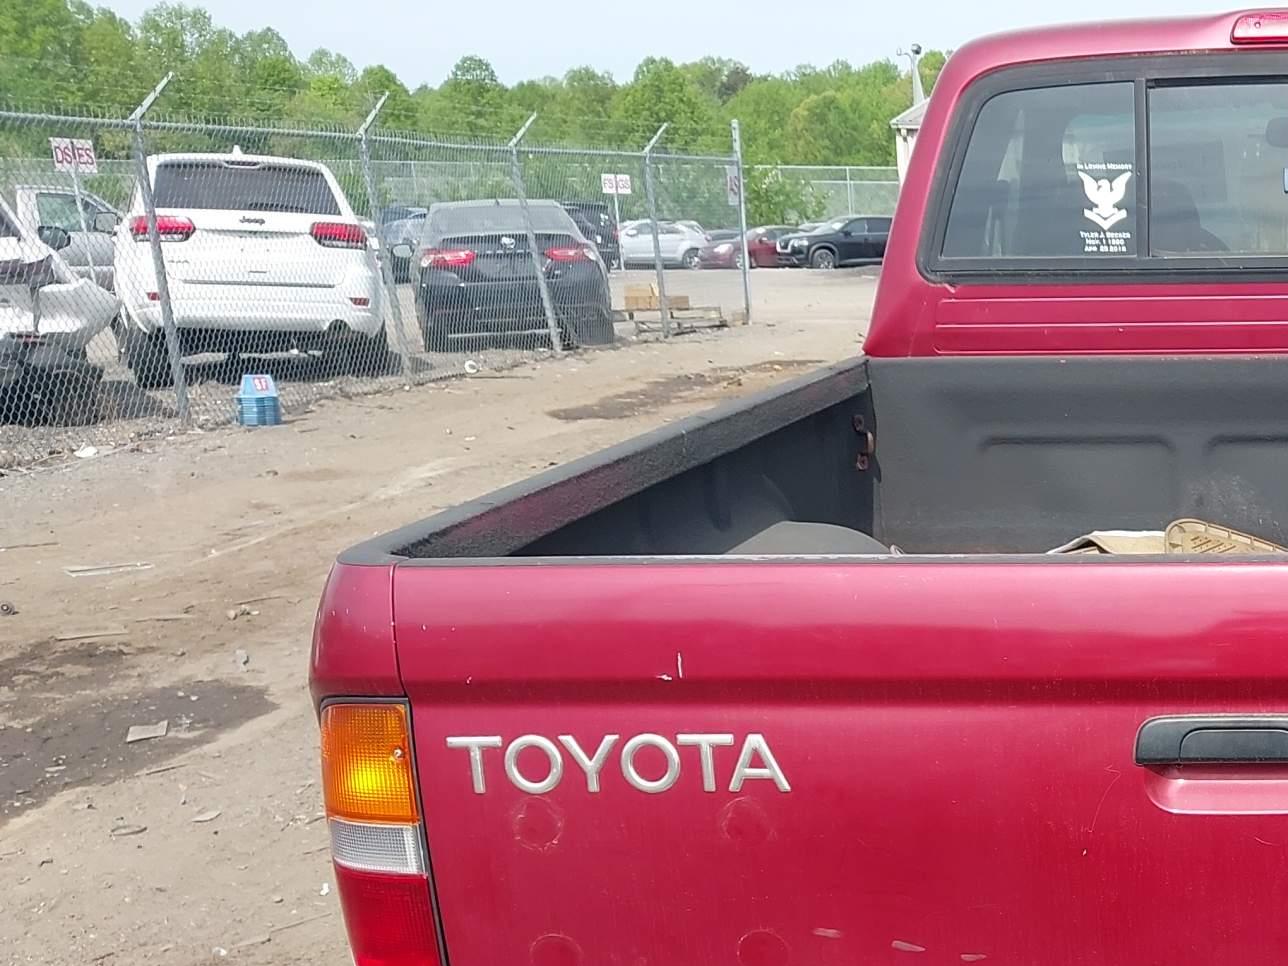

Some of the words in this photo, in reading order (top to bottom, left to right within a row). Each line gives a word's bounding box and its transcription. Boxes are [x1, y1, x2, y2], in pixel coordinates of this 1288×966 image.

[54, 145, 73, 164] DS
[77, 146, 95, 166] ES
[445, 733, 792, 795] TOYOTA
